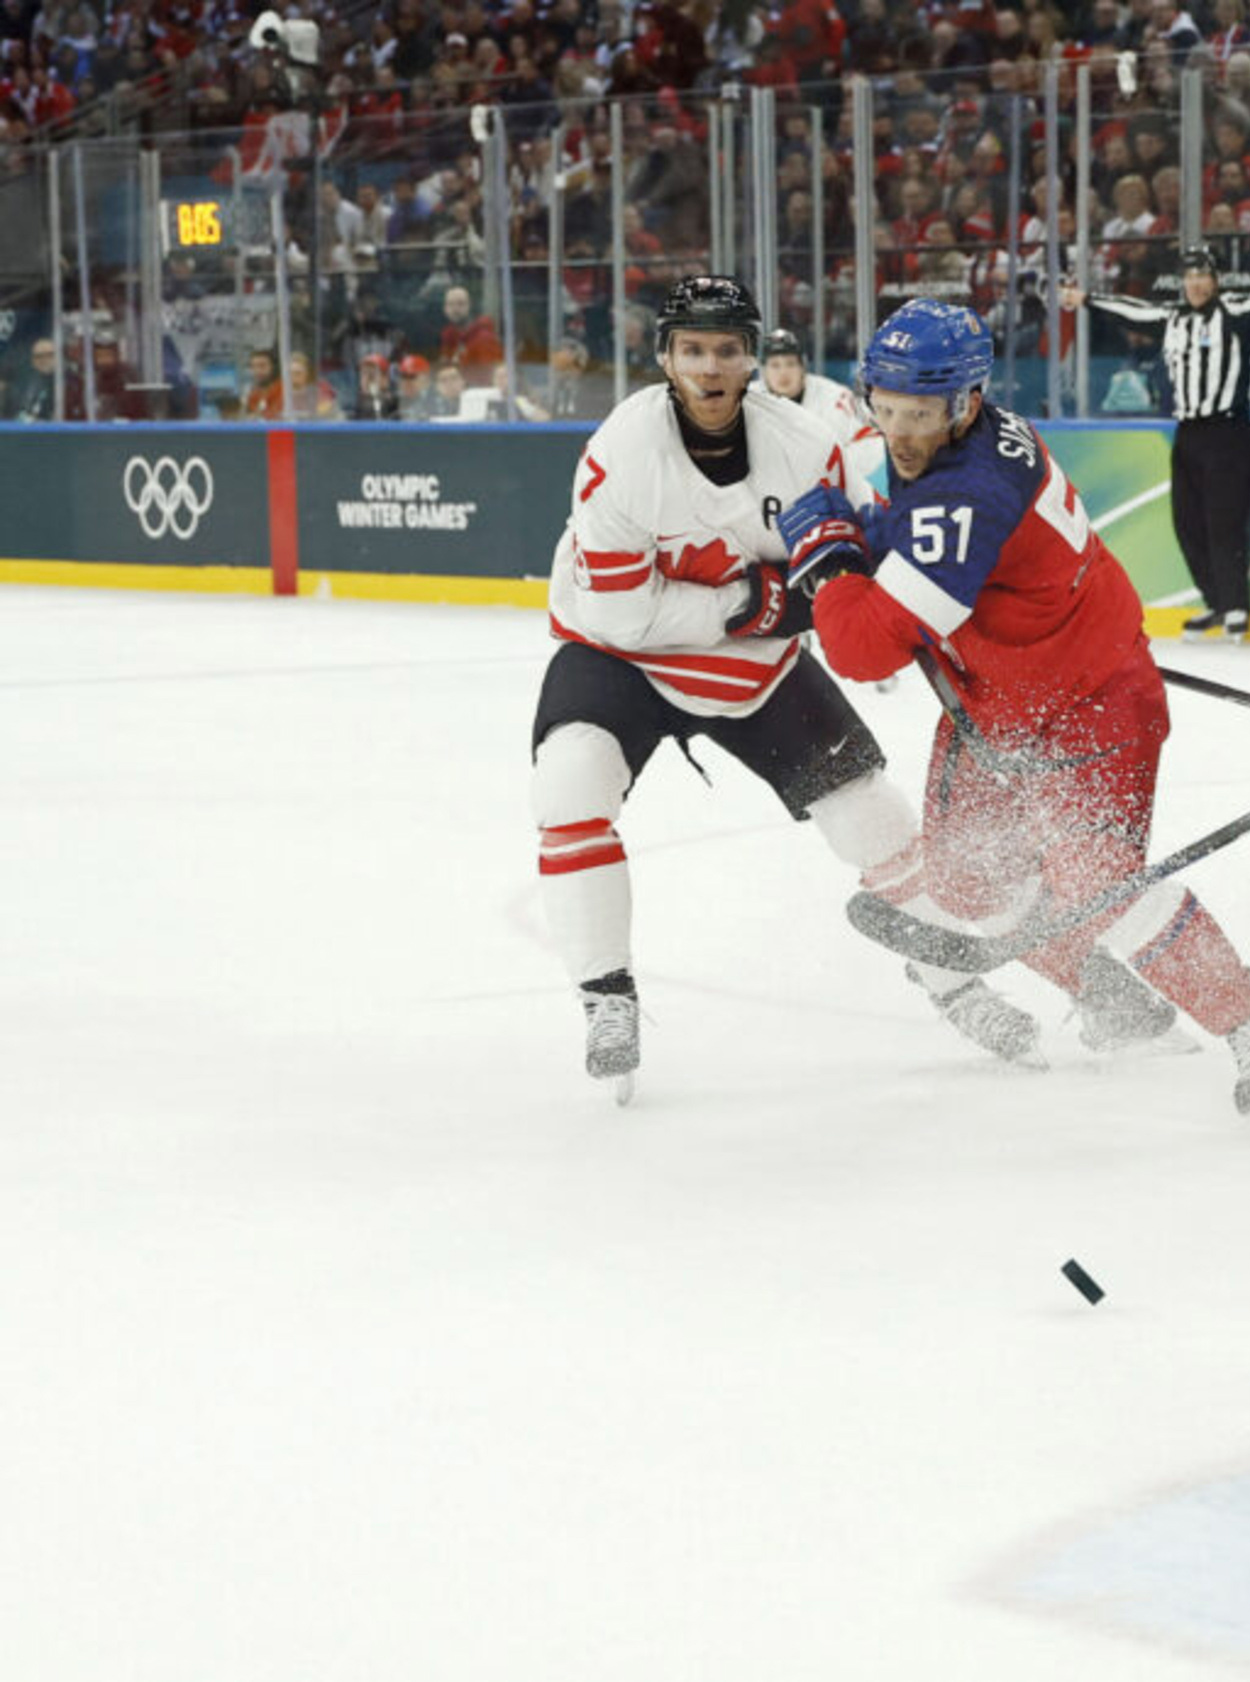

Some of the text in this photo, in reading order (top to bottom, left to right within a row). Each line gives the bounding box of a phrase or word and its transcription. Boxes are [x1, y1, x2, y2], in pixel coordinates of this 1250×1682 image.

[362, 473, 440, 501] OLYMPIC
[336, 501, 402, 528] WINTER
[911, 506, 973, 565] 51
